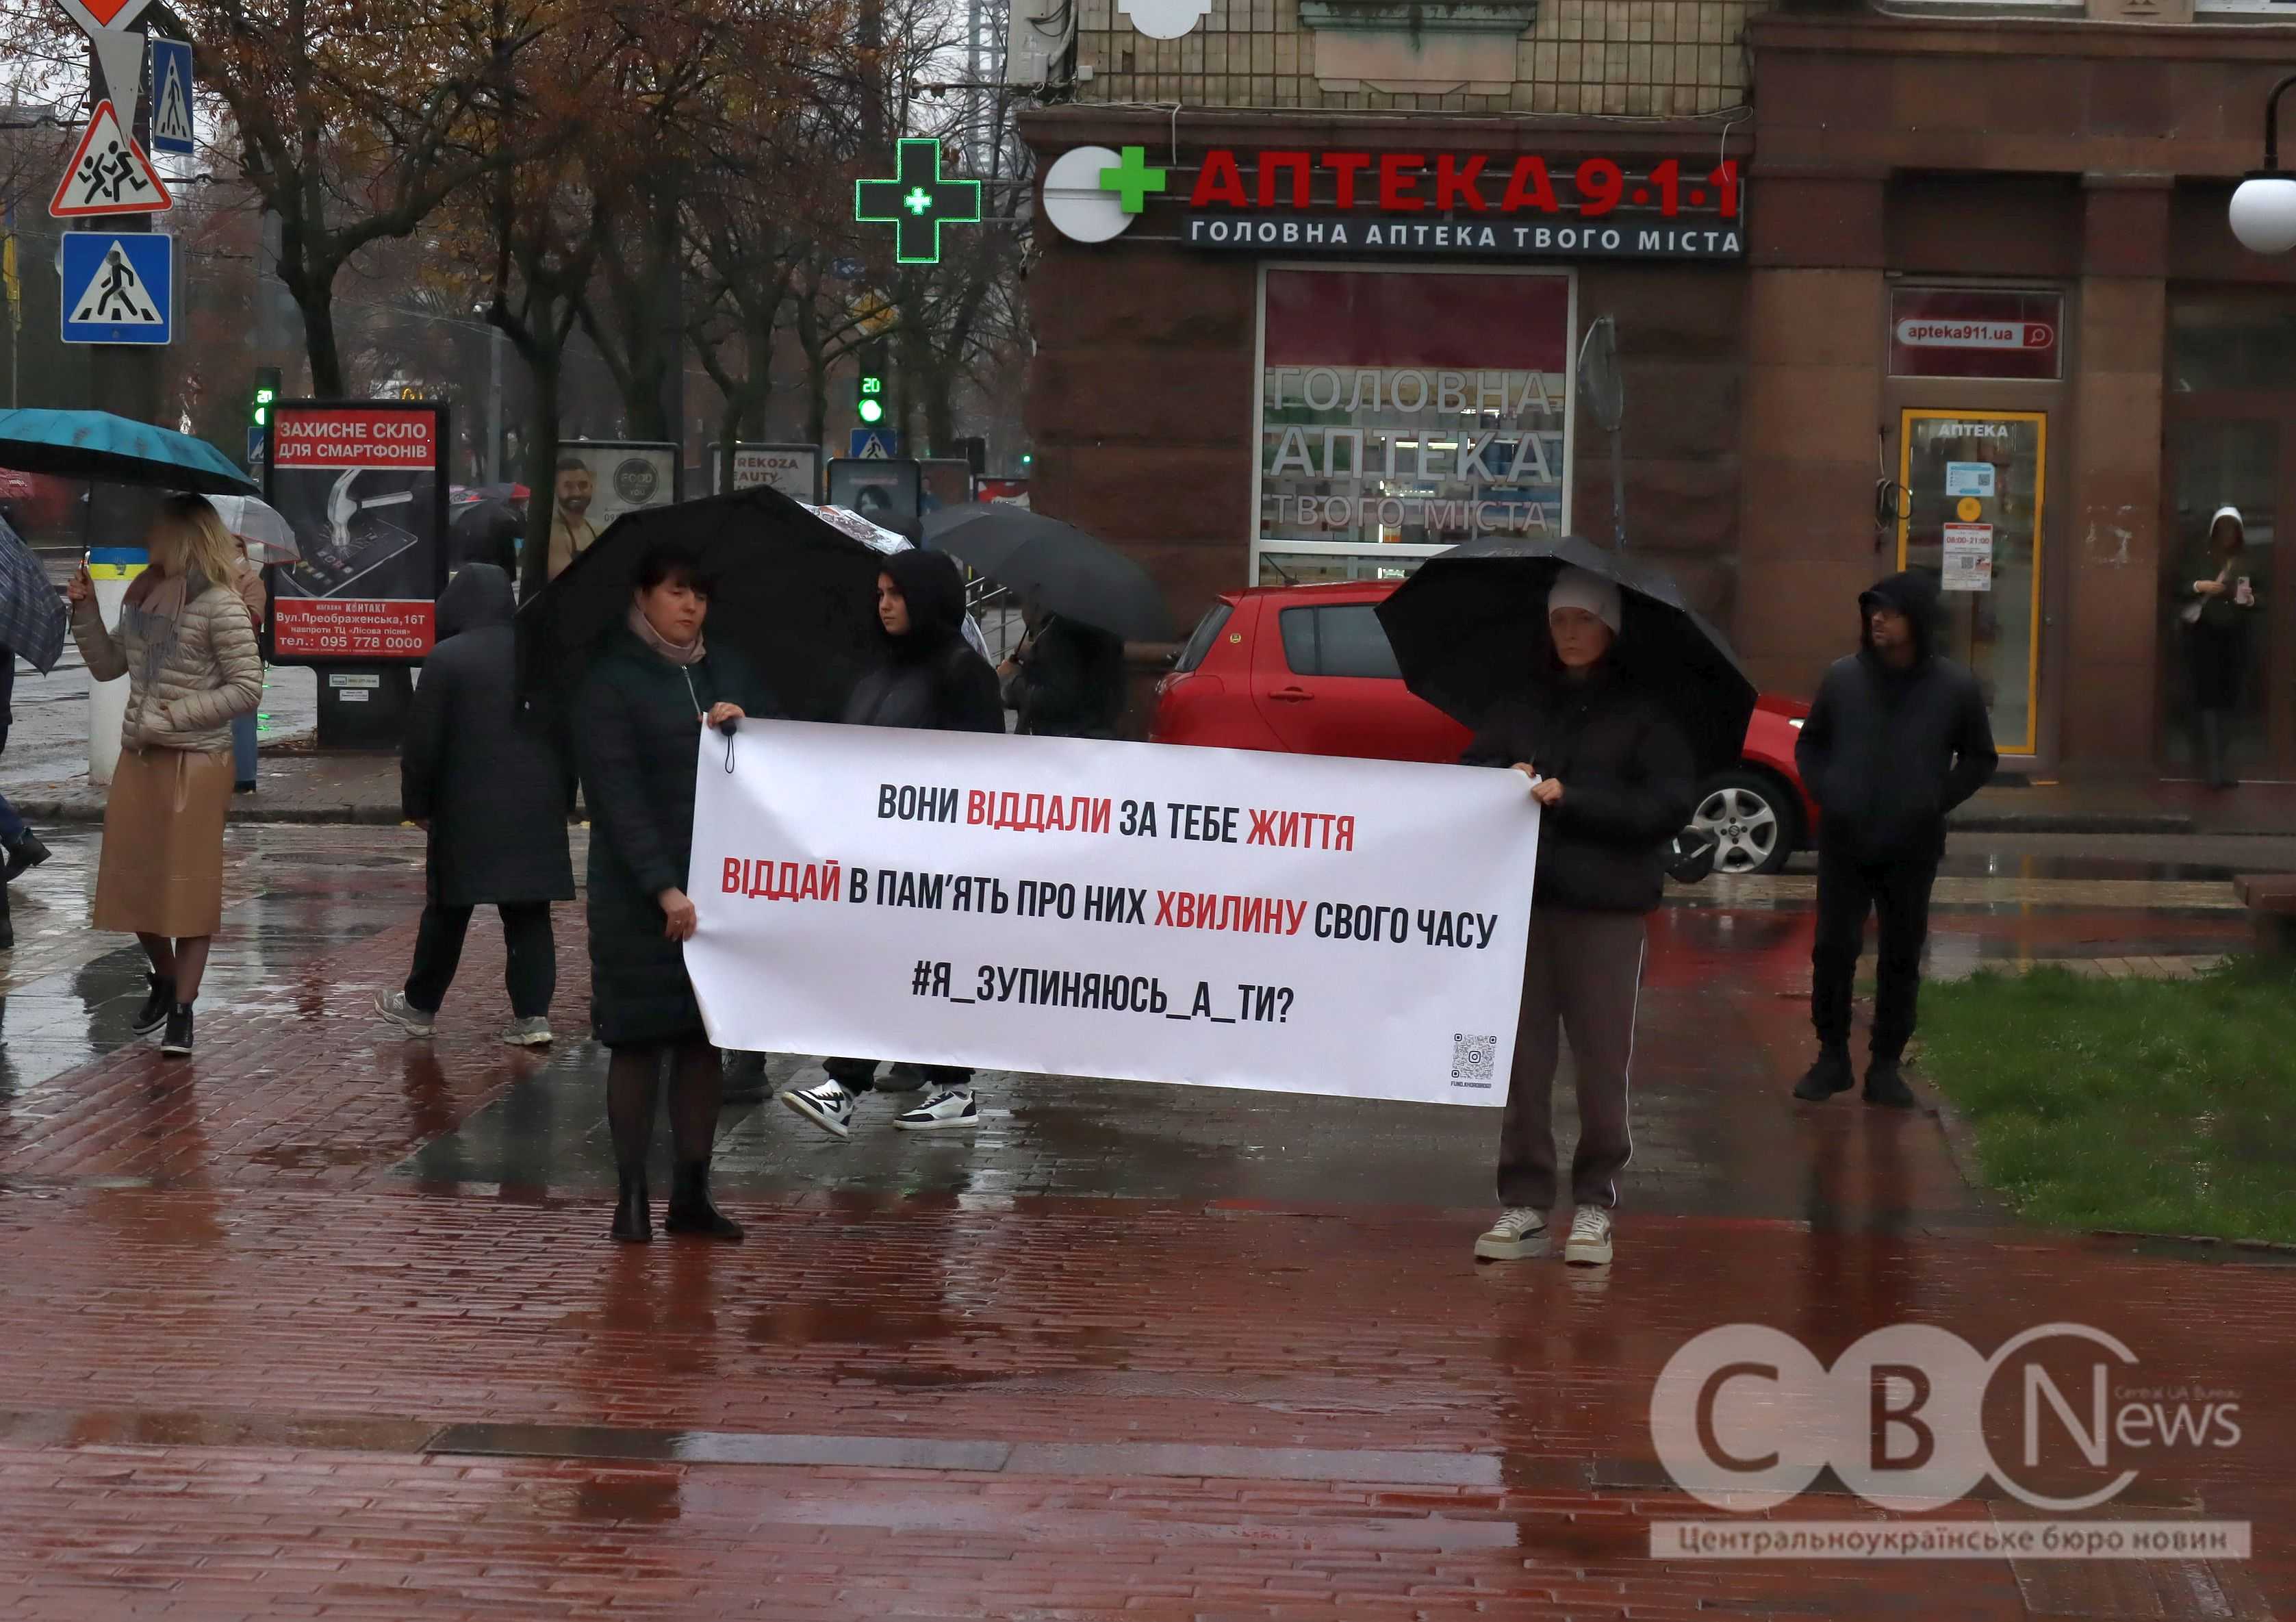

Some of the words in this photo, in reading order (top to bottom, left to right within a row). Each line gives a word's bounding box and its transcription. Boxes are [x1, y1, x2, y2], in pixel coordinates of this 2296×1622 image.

[1189, 150, 1559, 212] АПТЕКА
[1191, 220, 1349, 244] ГОЛОВНА
[1365, 224, 1496, 247] АПТЕКА
[1514, 227, 1621, 250] ТВОГО
[1637, 230, 1740, 253] МІСТА
[1907, 325, 2013, 341] apteka911.ua
[863, 378, 880, 393] 20
[1271, 366, 1553, 416] ГОЛОВНА
[280, 421, 368, 438] ЗАХИСНЕ
[372, 422, 427, 439] СКЛО
[1938, 423, 2008, 438] АПТЕКА
[279, 443, 311, 459] ДЛЯ
[317, 444, 428, 459] СМАРТФОНІВ
[735, 457, 799, 470] REKOZA
[1269, 424, 1553, 484] АПТЕКА
[1271, 494, 1406, 528] ТВОГО
[1424, 500, 1549, 532] МІСТА
[279, 637, 314, 646] тел.:
[320, 635, 348, 647] 095
[353, 637, 380, 648] 778
[385, 637, 422, 648] 0000
[290, 626, 331, 635] навпроти
[334, 626, 346, 635] ТЦ
[877, 783, 960, 823] ВОНИ
[966, 789, 1112, 834] ВІДДАЛИ
[1120, 800, 1157, 838] ЗА
[1166, 802, 1240, 844] ТЕБЕ
[1246, 808, 1355, 852] ЖИТТЯ
[721, 857, 841, 902] ВІДДАЙ
[848, 867, 869, 903] В
[1017, 879, 1075, 920] ПРО
[1084, 885, 1147, 925] НИХ
[1154, 890, 1308, 936] ХВИЛИНУ
[1314, 901, 1410, 943] СВОГО
[1416, 909, 1499, 950] ЧАСУ
[912, 960, 1295, 1024] #Я_ЗУПИНЯЮСЬ_А_ТИ?
